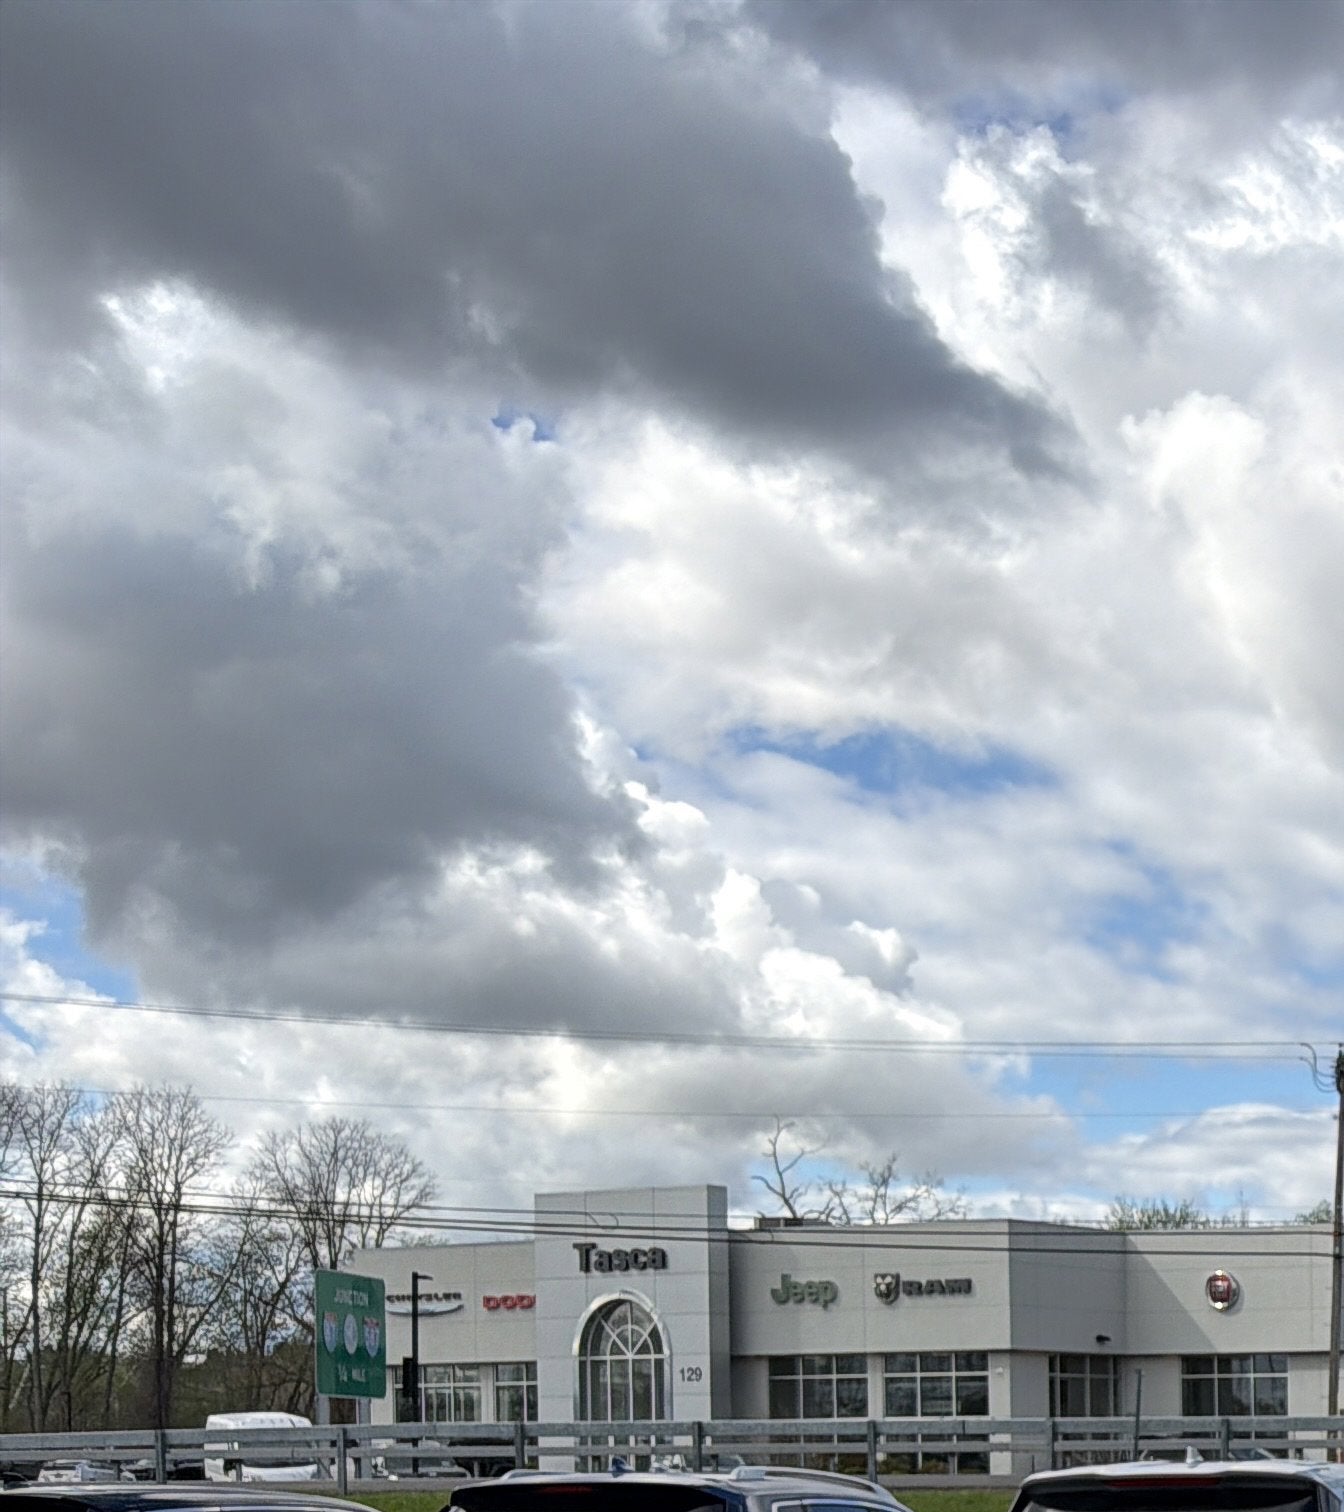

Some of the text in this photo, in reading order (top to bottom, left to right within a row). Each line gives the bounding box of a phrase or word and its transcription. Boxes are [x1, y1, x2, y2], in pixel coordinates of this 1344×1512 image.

[573, 1243, 668, 1274] Tasca
[770, 1273, 838, 1311] Jeep
[901, 1278, 972, 1297] RAM
[482, 1294, 536, 1312] DOD
[679, 1366, 703, 1383] 129
